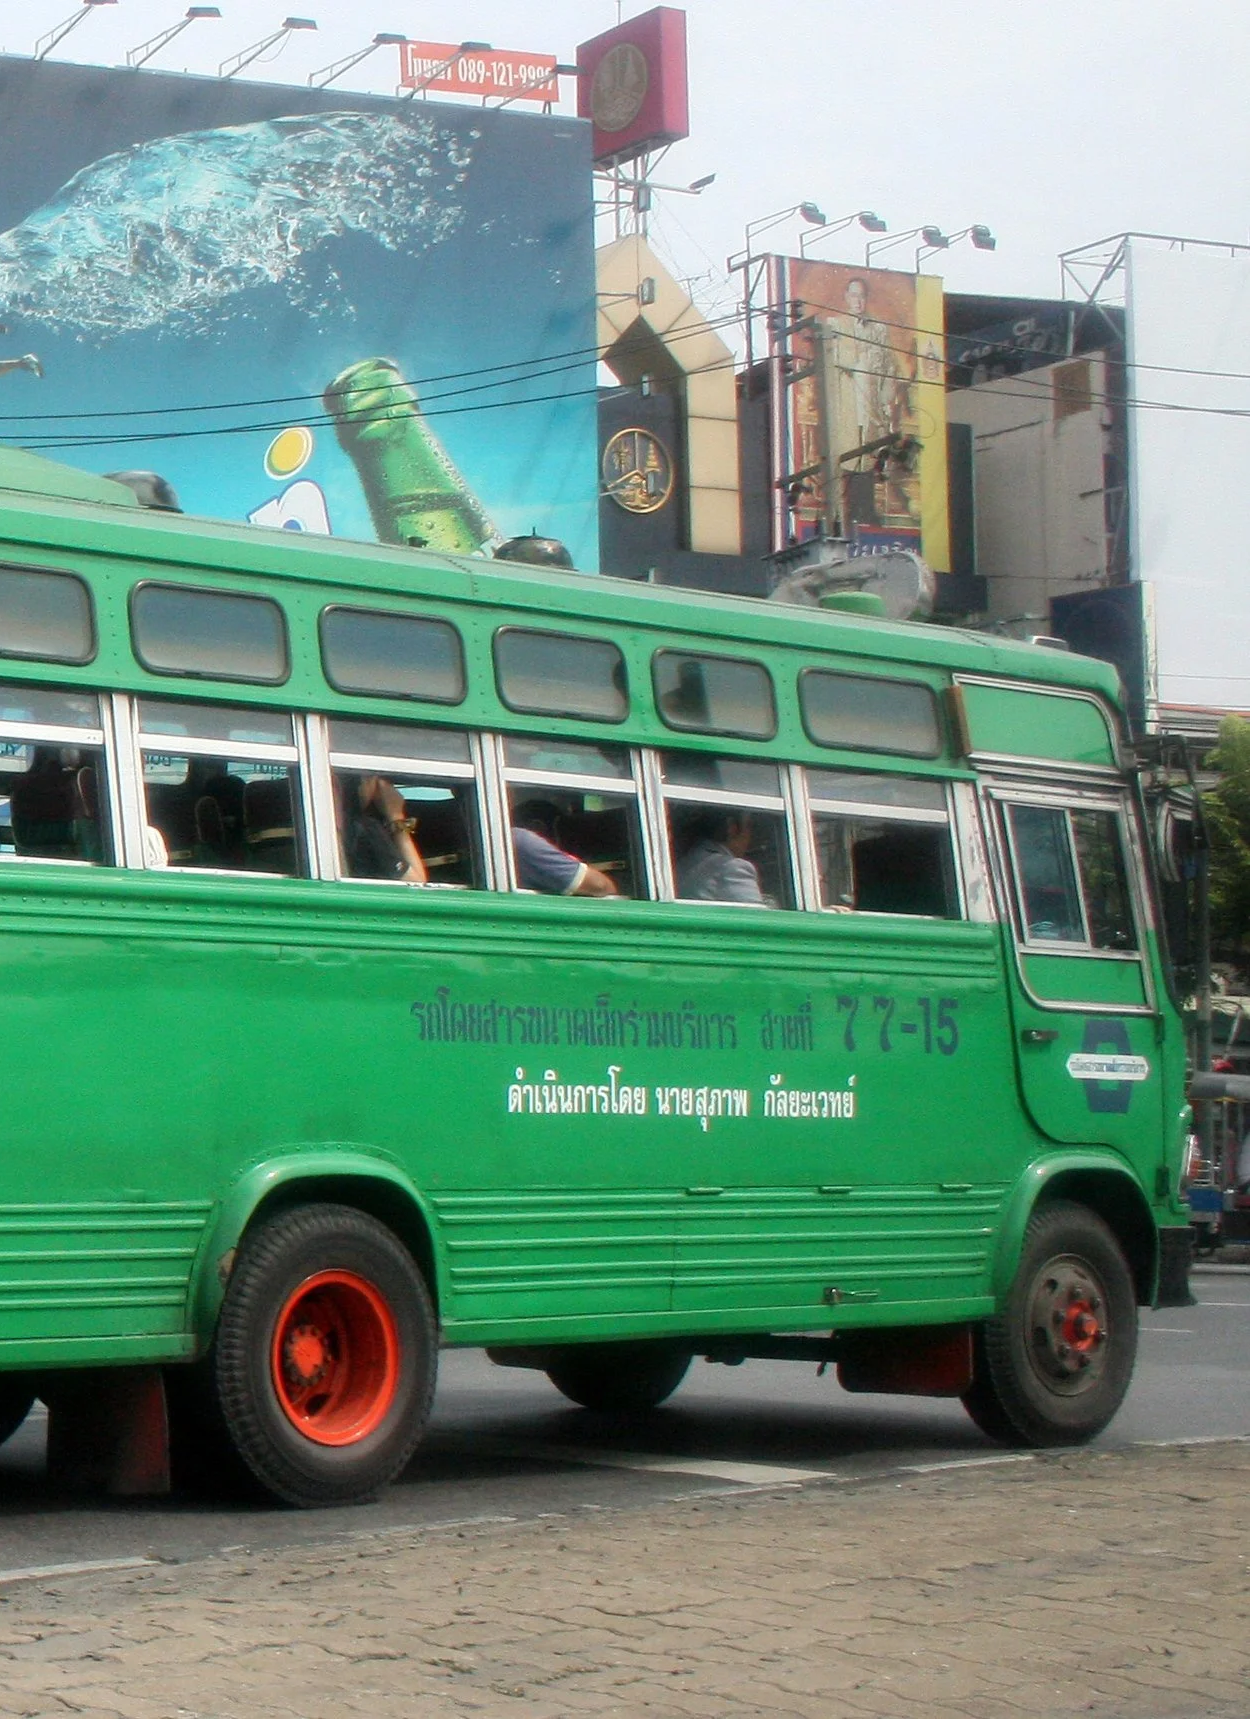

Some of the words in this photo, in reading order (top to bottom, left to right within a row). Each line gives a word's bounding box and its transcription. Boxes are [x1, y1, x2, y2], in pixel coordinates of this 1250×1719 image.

[761, 994, 813, 1051] สายที่
[507, 1066, 646, 1114] ดำเนินการโดย
[655, 1085, 748, 1131] นายสุภาพ
[763, 1073, 856, 1118] กัลยะเวทย์
